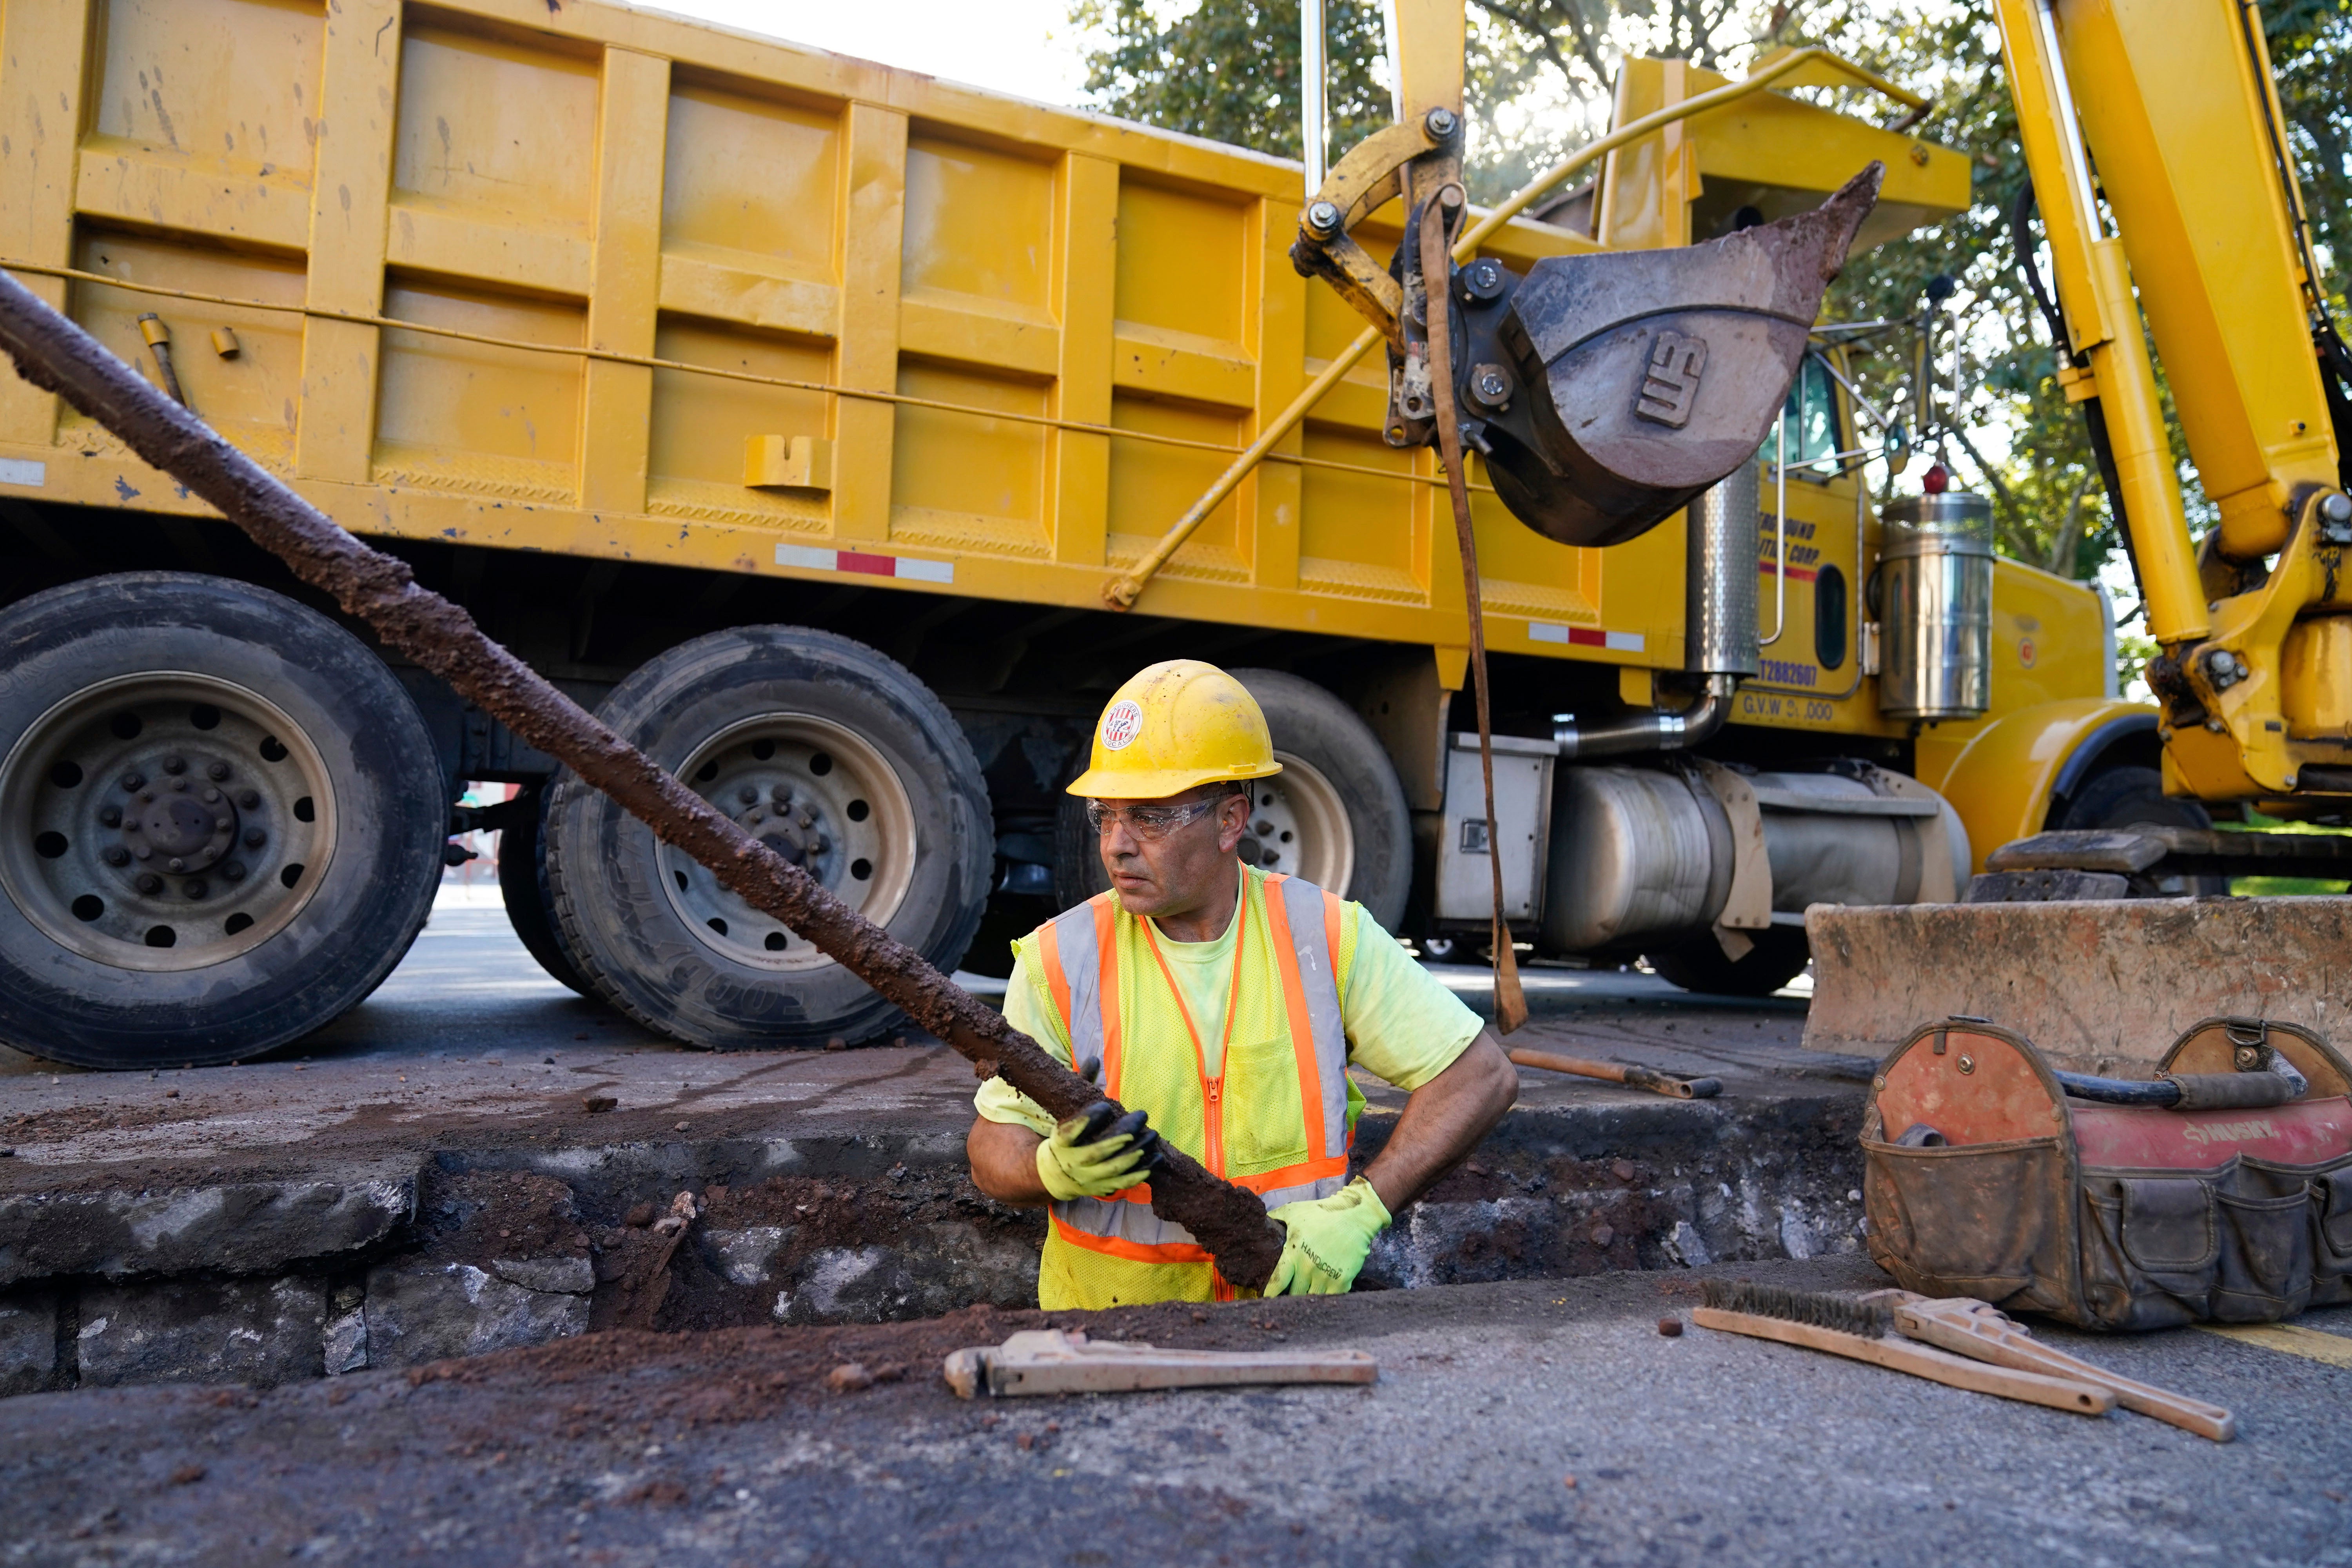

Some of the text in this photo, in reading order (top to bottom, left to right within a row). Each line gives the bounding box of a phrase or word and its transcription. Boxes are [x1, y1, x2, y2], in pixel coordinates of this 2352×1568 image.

[1110, 704, 1138, 717] LABORERS
[1107, 717, 1132, 733] 472
[1105, 737, 1127, 747] LOCAL
